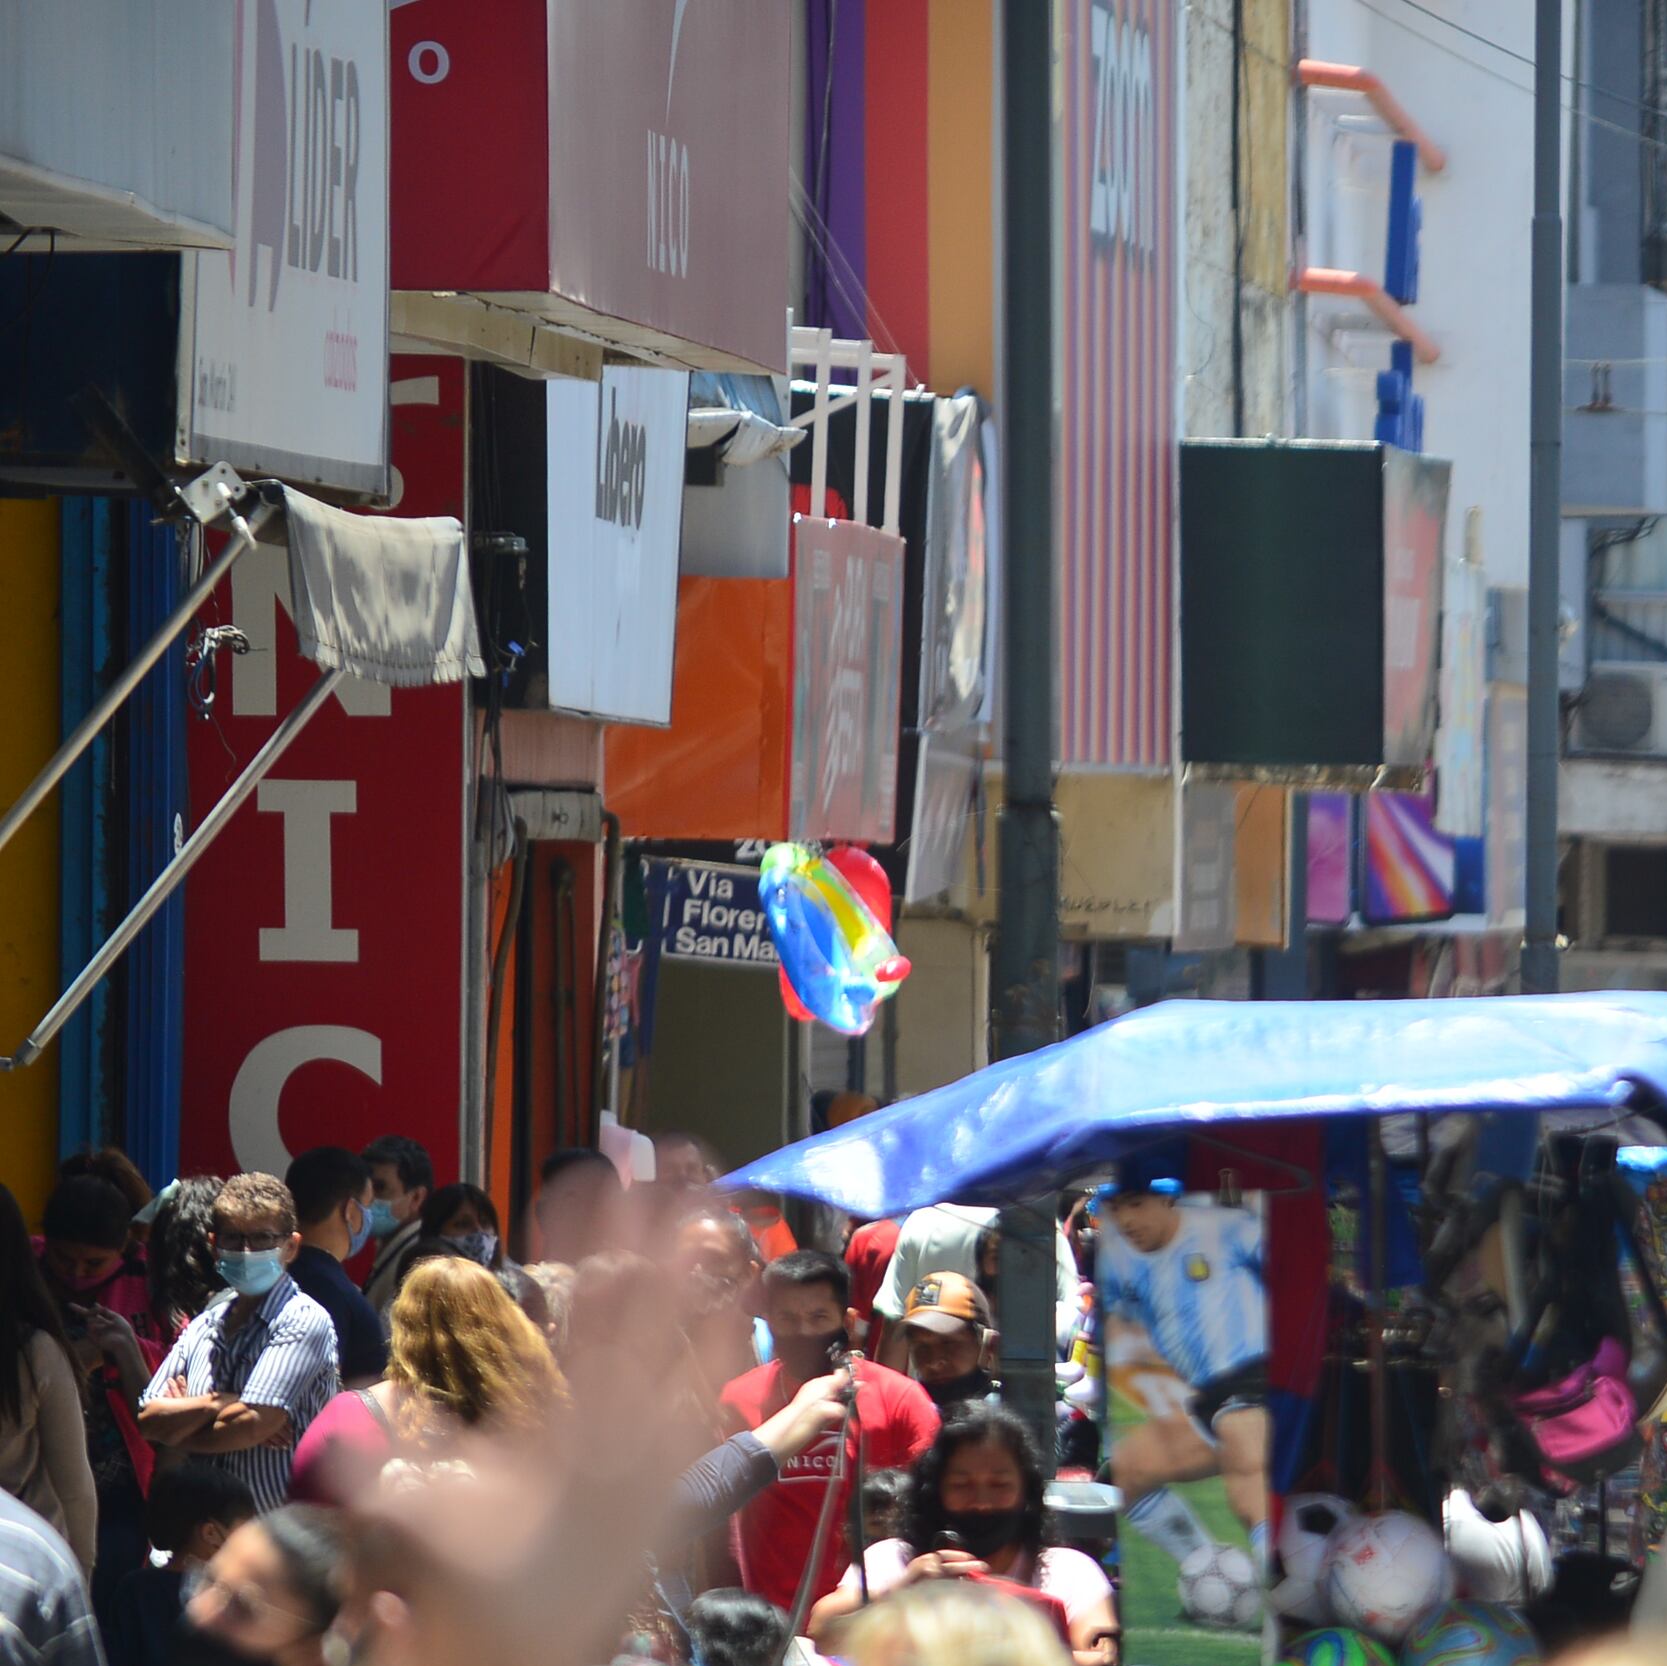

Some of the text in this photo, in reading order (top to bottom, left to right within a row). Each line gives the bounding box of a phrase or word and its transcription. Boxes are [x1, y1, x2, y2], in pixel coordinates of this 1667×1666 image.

[646, 128, 690, 279] NICO
[687, 868, 734, 899] Via
[676, 927, 779, 962] San Ma
